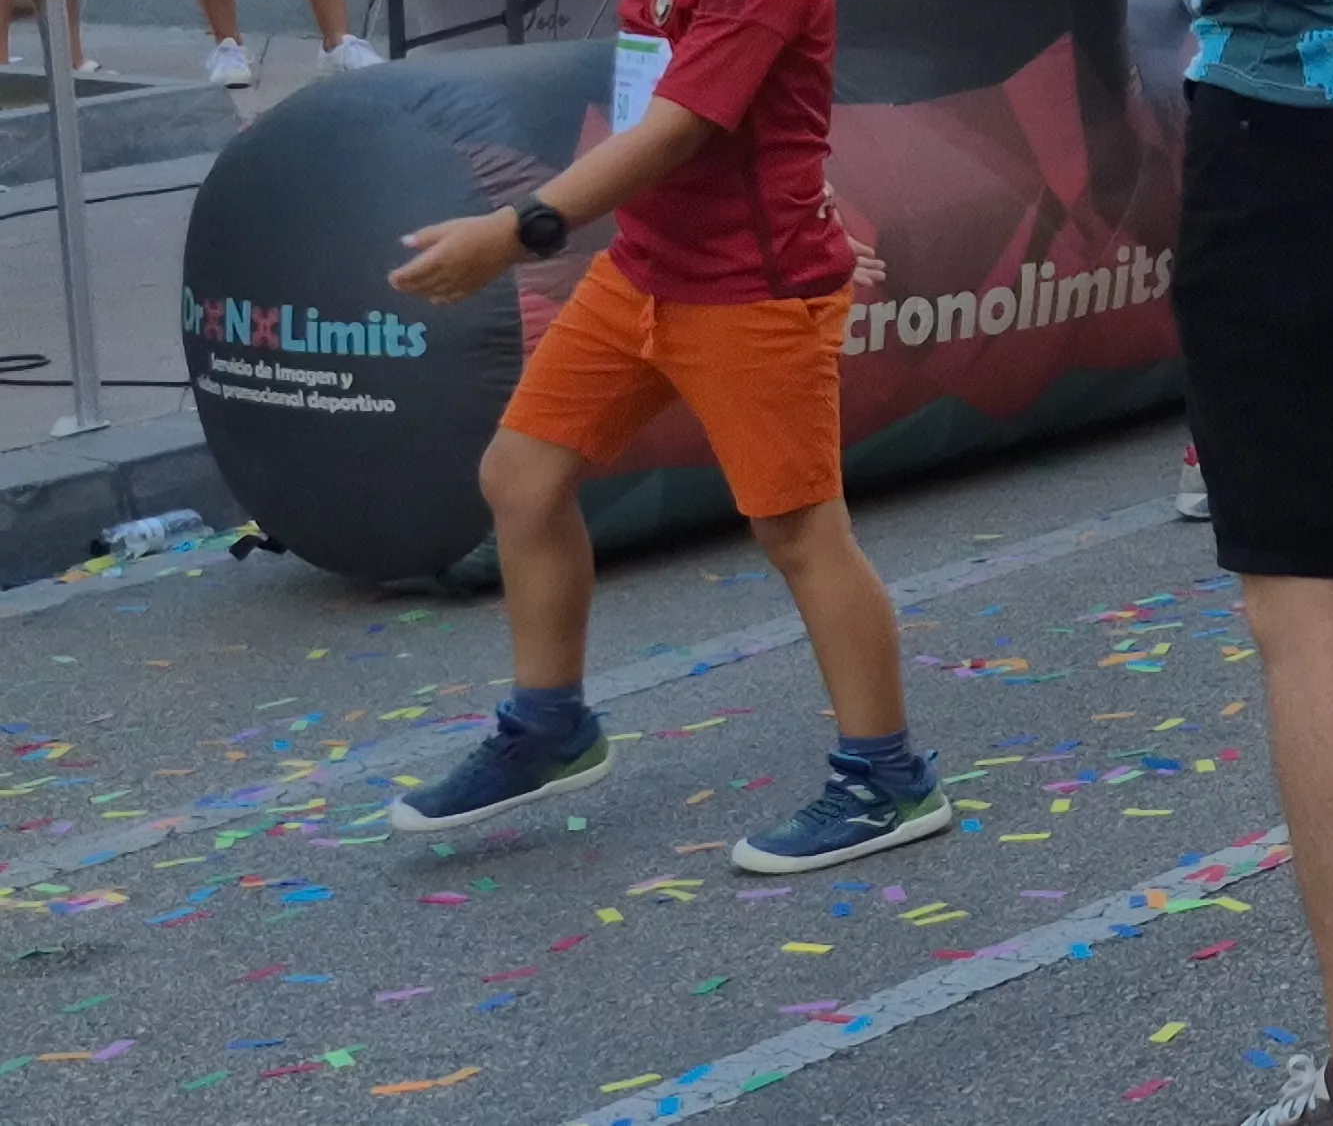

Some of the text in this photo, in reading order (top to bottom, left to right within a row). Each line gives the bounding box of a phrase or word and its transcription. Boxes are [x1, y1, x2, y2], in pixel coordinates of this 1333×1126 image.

[842, 245, 1175, 356] cronolimits
[340, 372, 353, 390] y
[307, 390, 397, 414] deportivo
